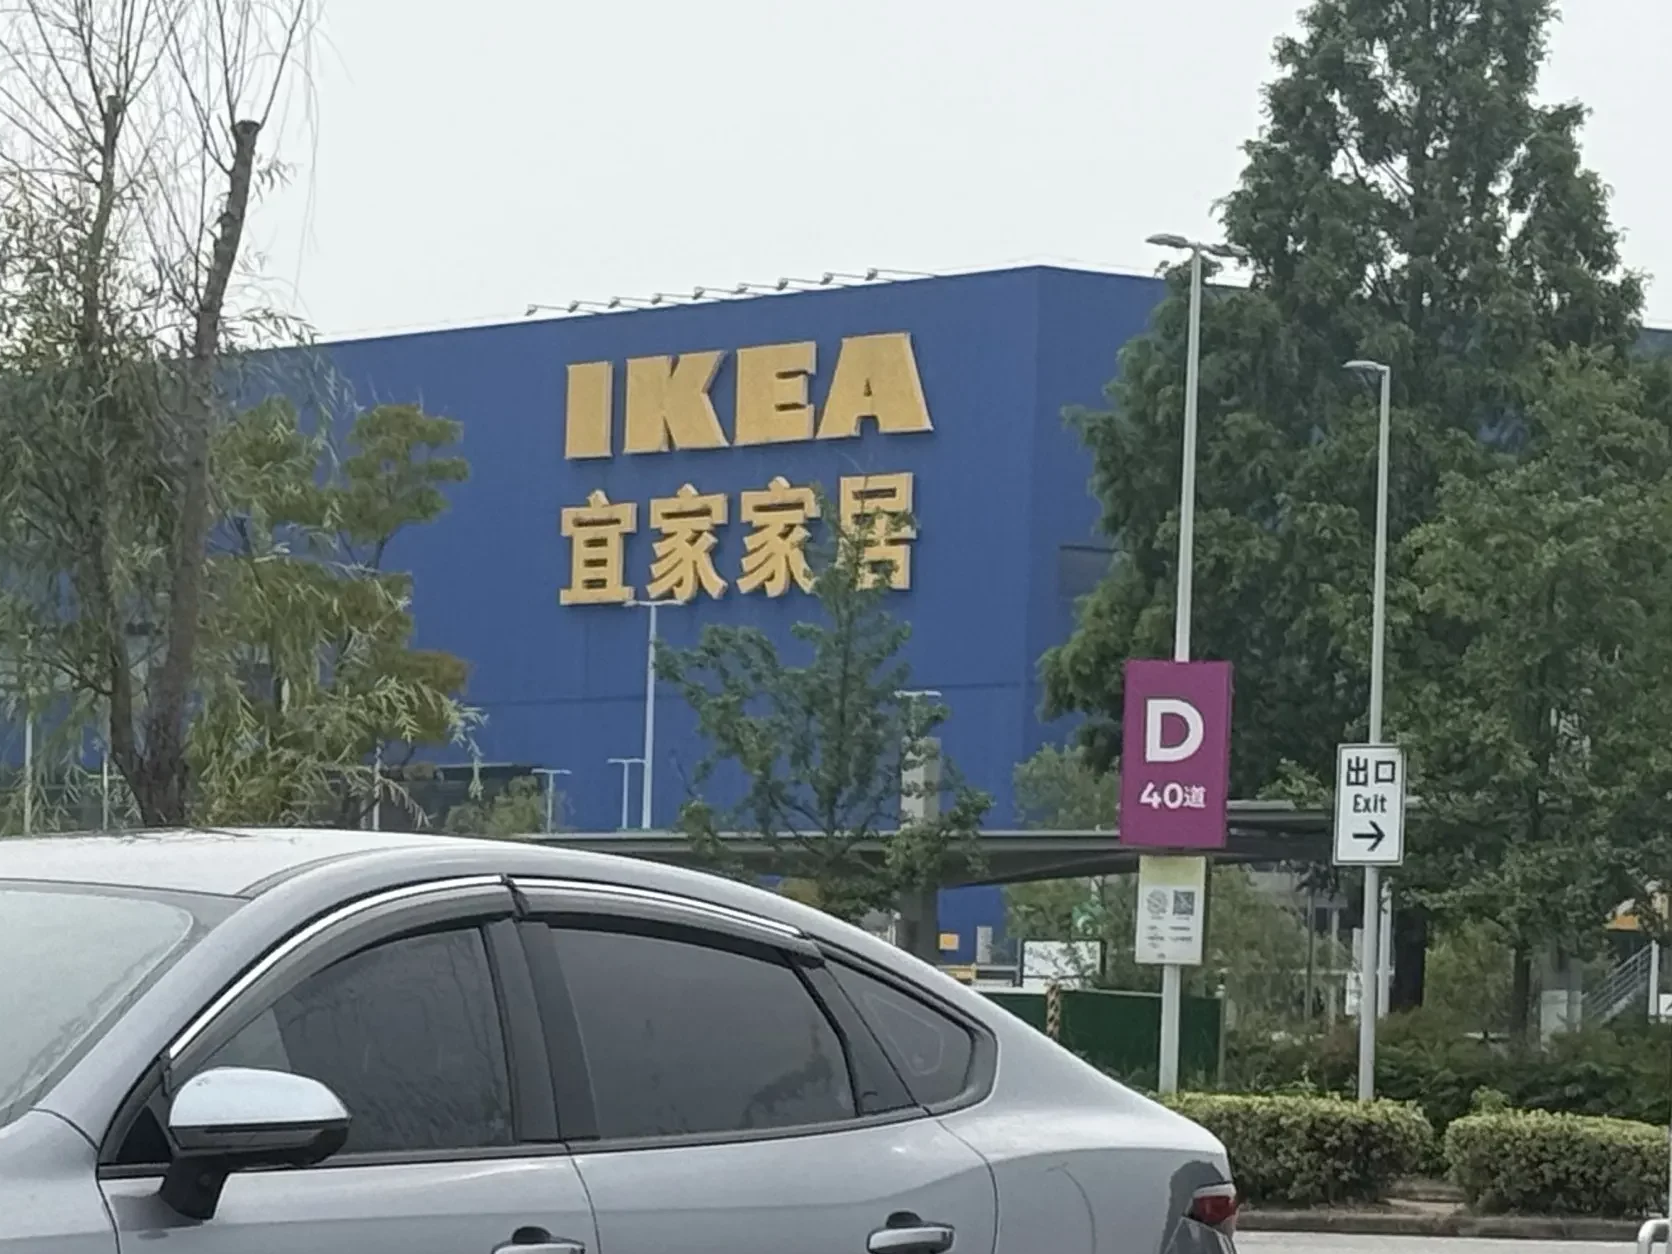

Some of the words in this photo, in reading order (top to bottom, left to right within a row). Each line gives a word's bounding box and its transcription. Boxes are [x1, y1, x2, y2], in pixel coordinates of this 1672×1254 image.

[564, 332, 935, 461] IKEA
[559, 472, 920, 606] 宜家家居
[1145, 699, 1204, 763] D
[1346, 756, 1396, 787] 出口
[1139, 781, 1207, 811] 40道
[1352, 793, 1387, 813] Exit
